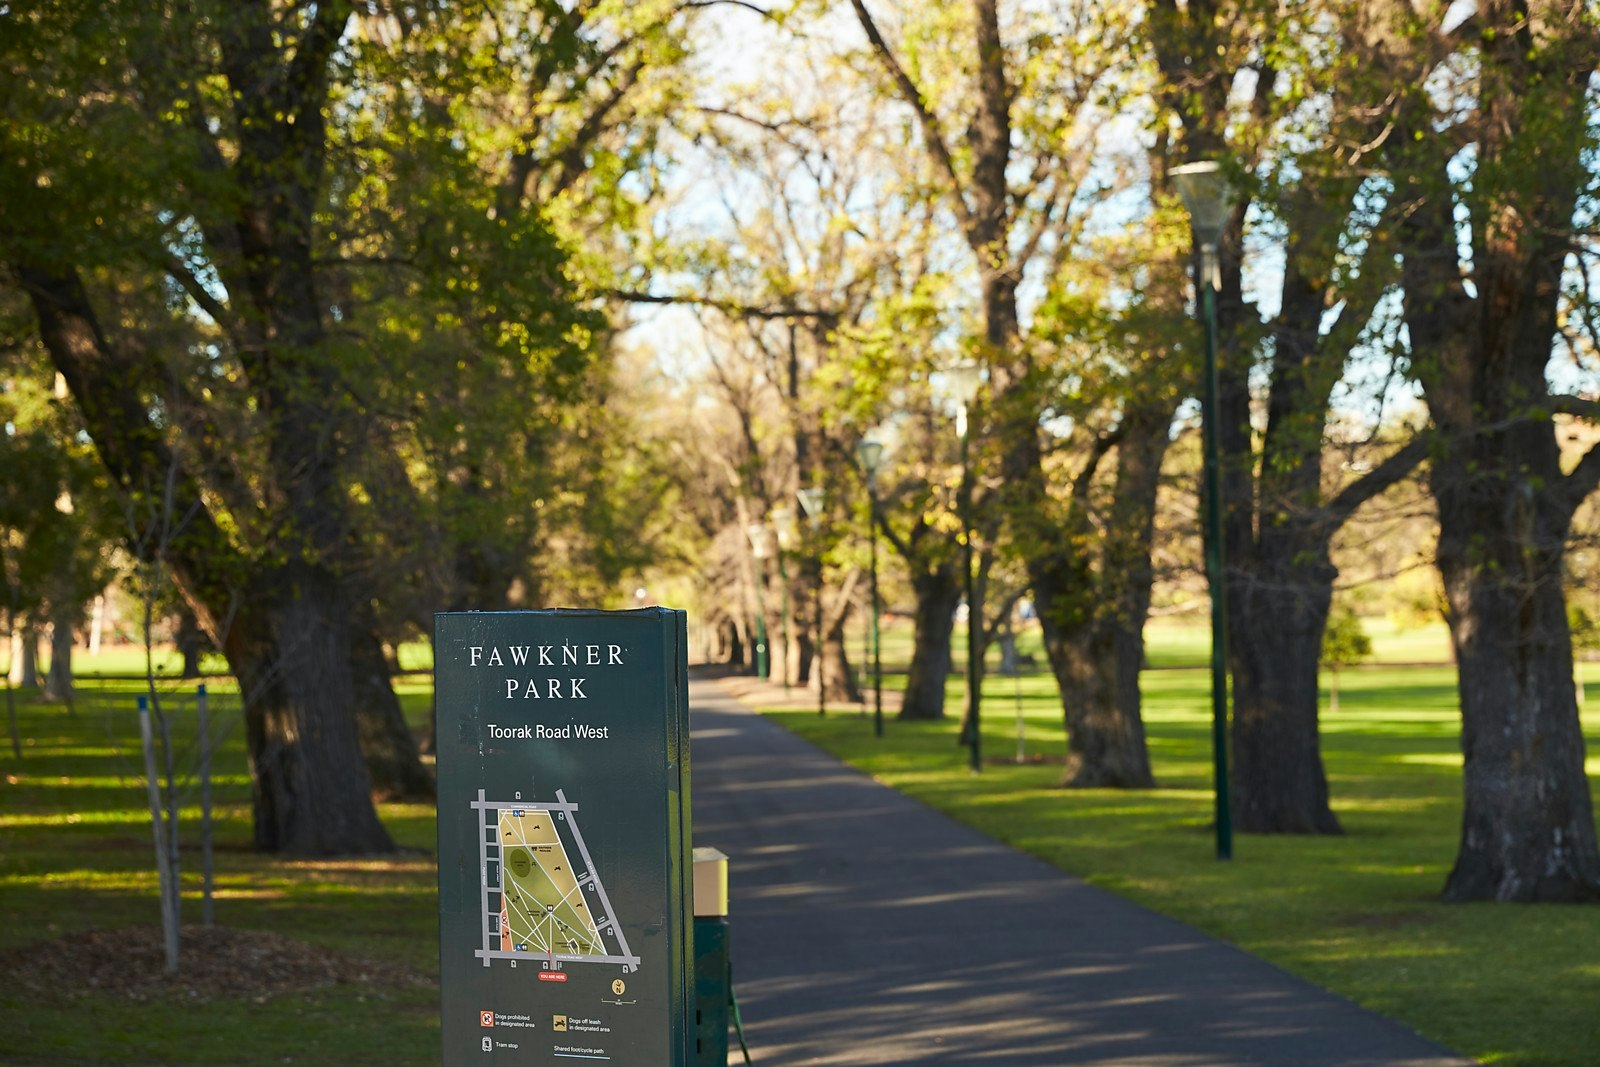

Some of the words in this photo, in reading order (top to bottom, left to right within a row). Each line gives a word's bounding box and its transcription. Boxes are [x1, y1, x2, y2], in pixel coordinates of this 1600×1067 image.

[469, 644, 624, 666] FAWKNER
[506, 678, 588, 699] PARK
[487, 724, 532, 739] Toorak
[536, 724, 570, 739] Road
[574, 724, 609, 739] West
